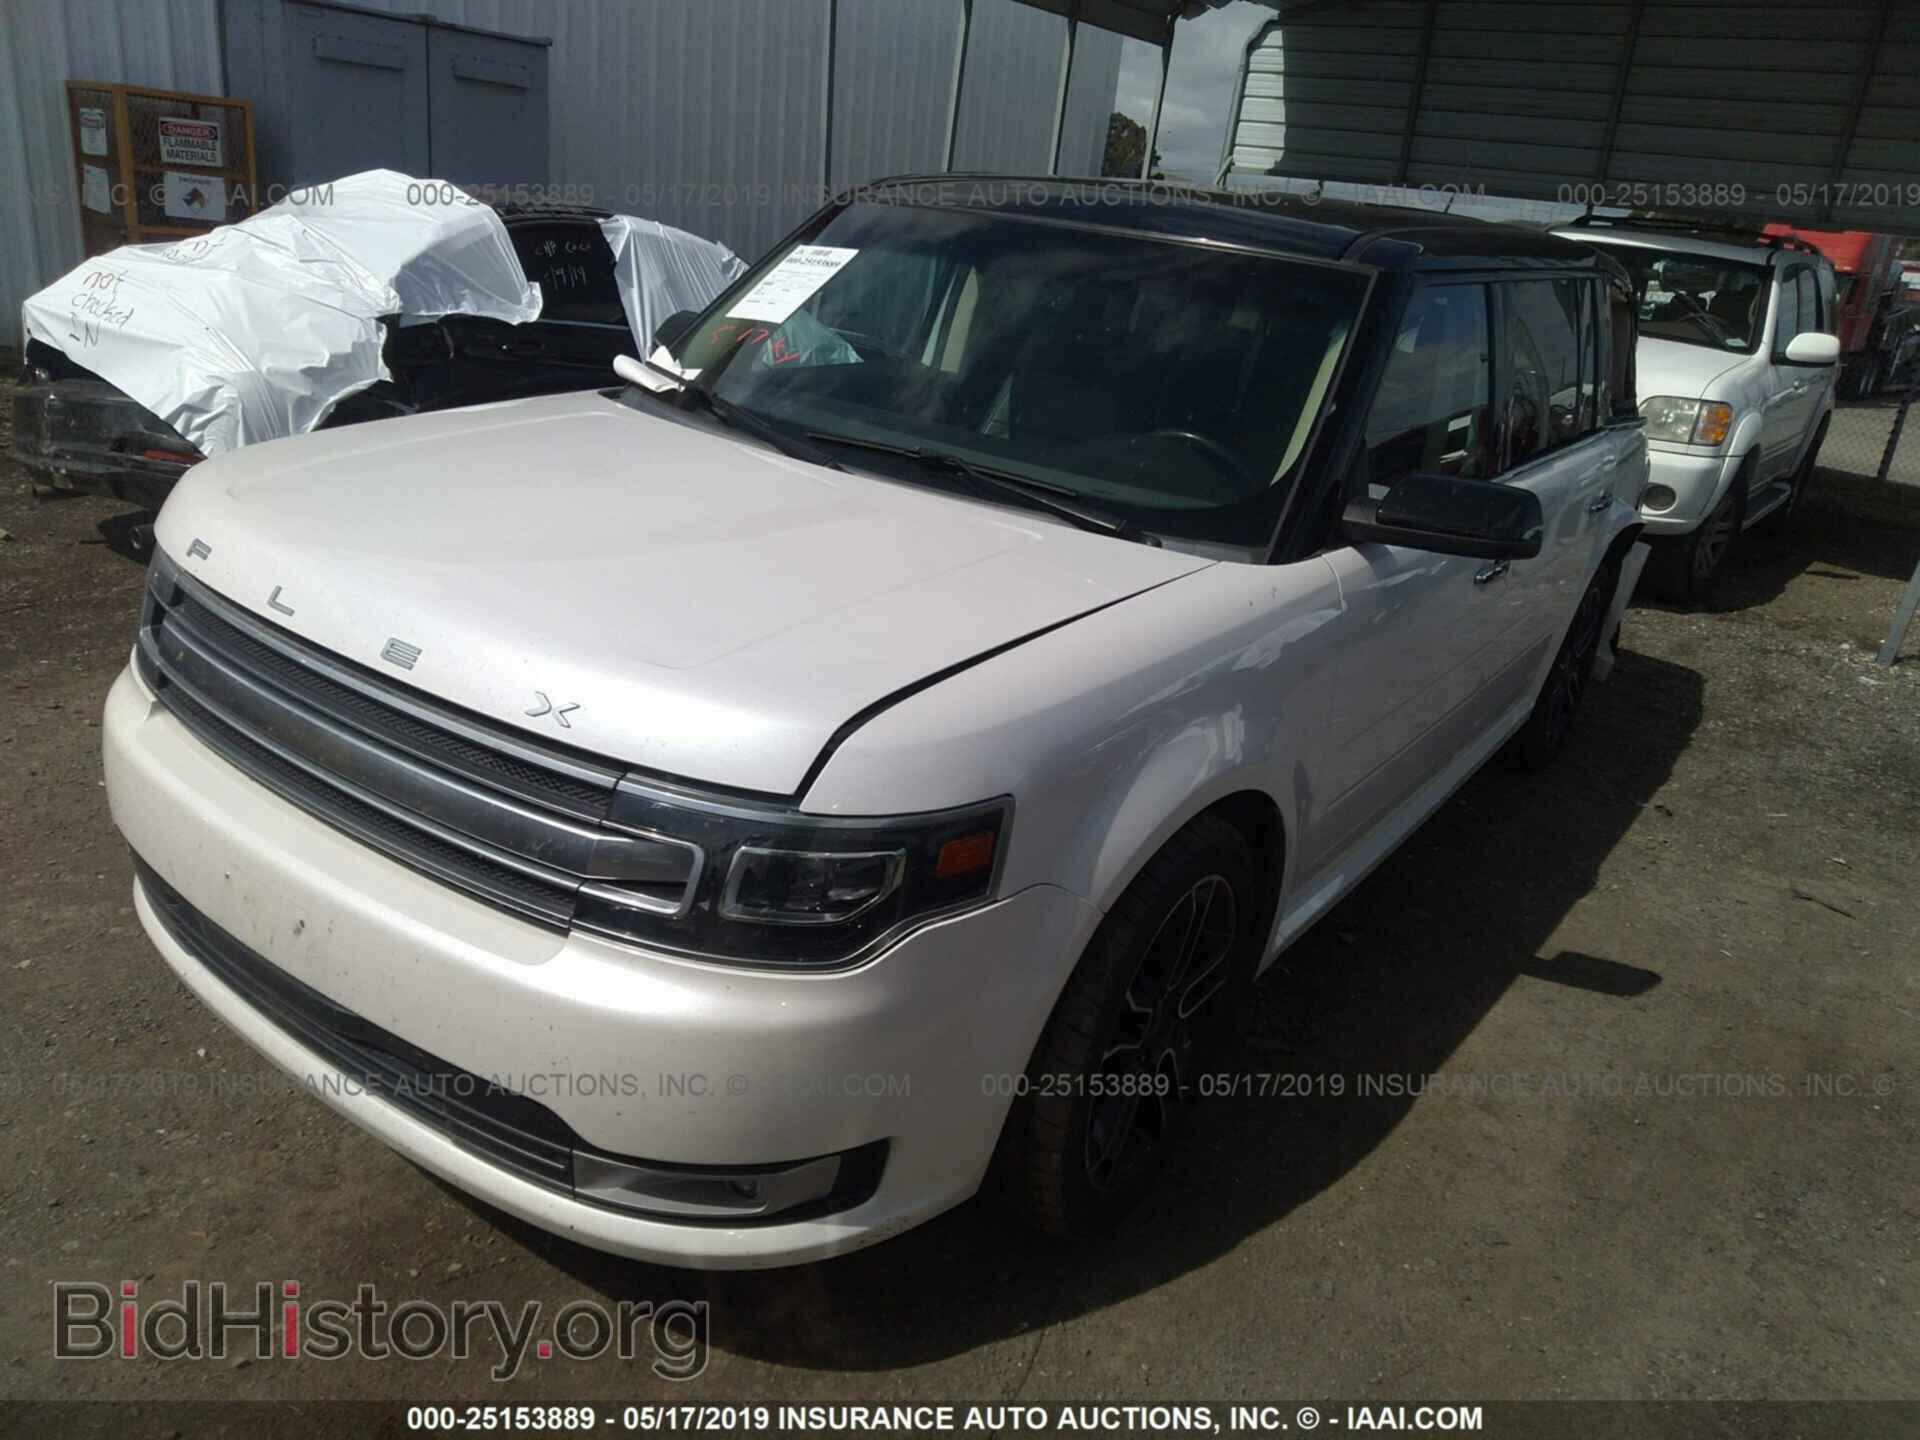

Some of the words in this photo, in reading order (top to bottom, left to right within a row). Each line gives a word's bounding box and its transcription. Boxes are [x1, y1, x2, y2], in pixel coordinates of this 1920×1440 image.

[167, 123, 211, 138] DANGER
[163, 136, 217, 151] FLAMMABLE
[166, 149, 217, 163] MATERIALS
[186, 537, 581, 729] FLEX
